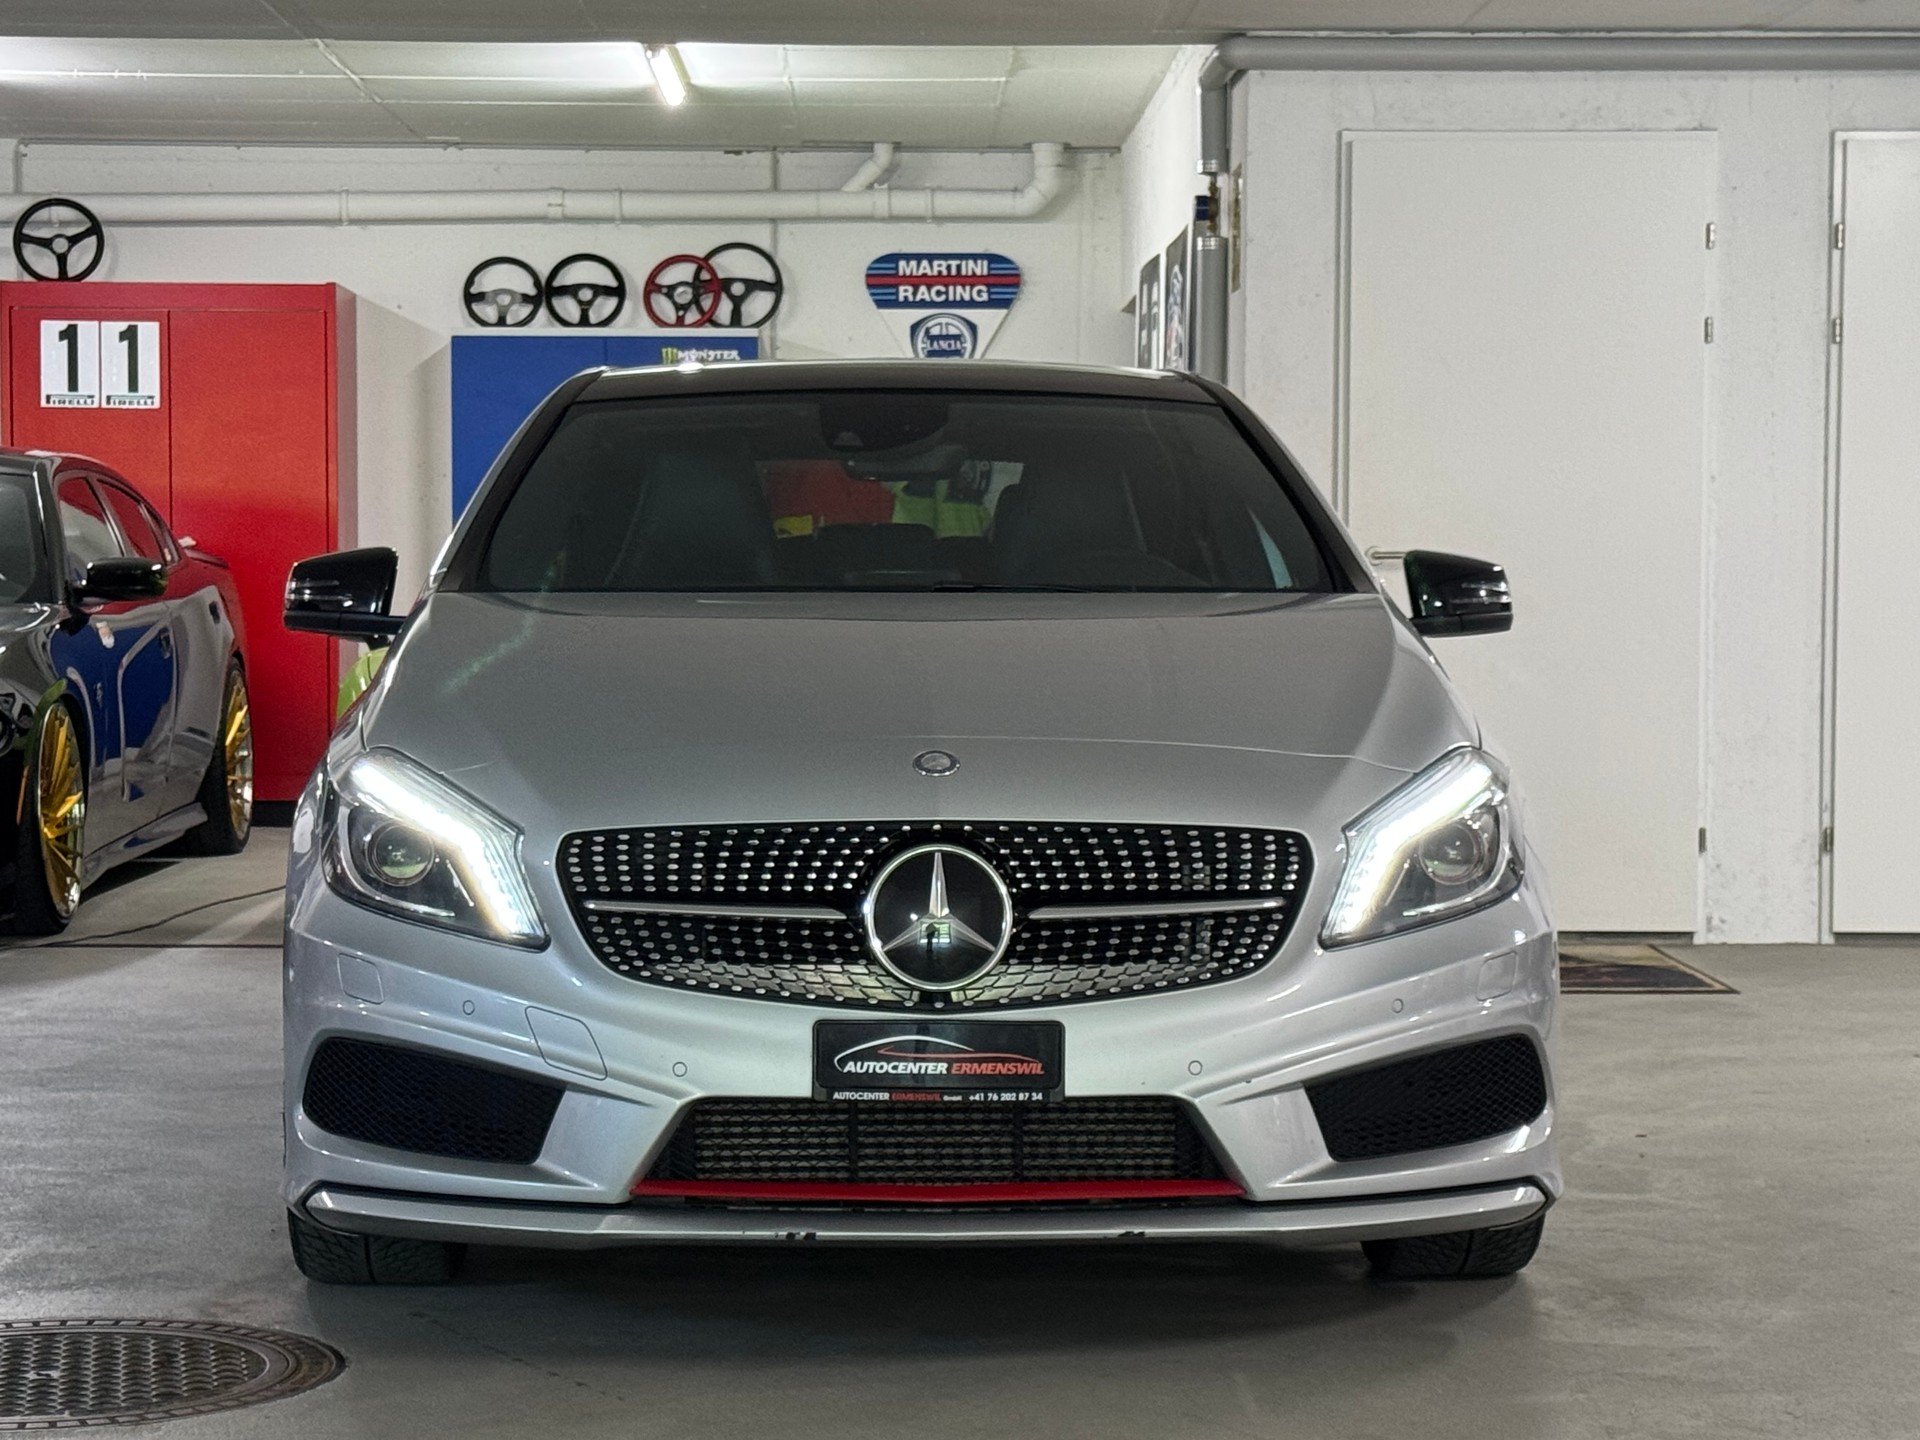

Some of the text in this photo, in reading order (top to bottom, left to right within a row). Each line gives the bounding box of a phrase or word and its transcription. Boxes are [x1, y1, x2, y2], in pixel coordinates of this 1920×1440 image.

[898, 260, 989, 276] MARTINI
[898, 285, 989, 302] RACING
[926, 340, 961, 350] LANCIA
[843, 1061, 1045, 1075] AUTOCENTER ERMENSWIL
[832, 1092, 890, 1101] AUTOCENTER
[968, 1093, 985, 1101] +41
[987, 1093, 999, 1101] 76
[1000, 1093, 1017, 1101] 202
[1018, 1093, 1030, 1101] 87
[1031, 1092, 1043, 1101] 34
